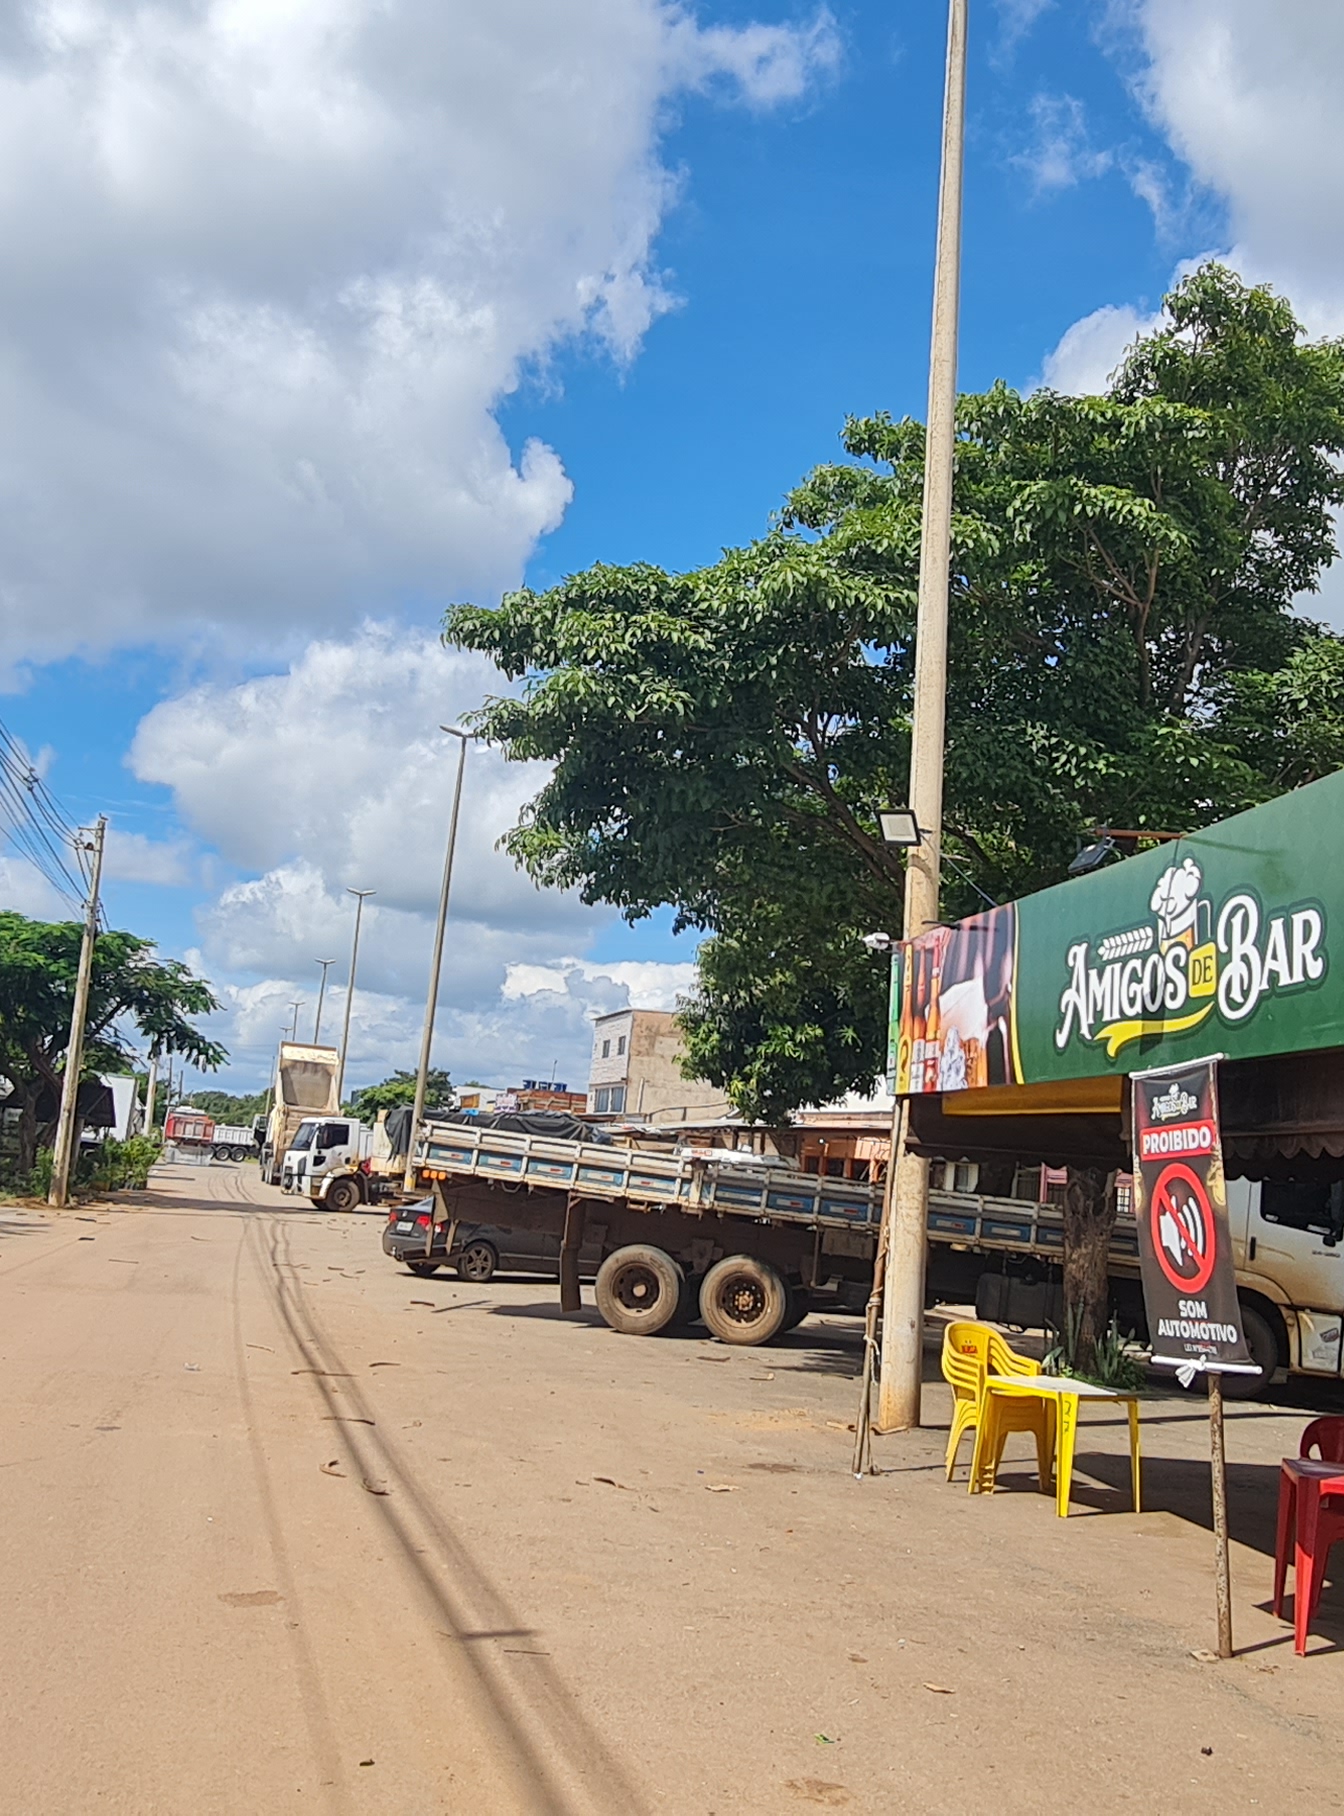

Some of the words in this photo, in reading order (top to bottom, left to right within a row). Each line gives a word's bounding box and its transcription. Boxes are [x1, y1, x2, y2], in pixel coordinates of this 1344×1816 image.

[1056, 942, 1188, 1048] AMIGOS
[1192, 955, 1214, 987] DE
[1217, 894, 1324, 1020] BAR
[1142, 1125, 1212, 1155] PROIBIDO
[1178, 1299, 1208, 1320] SOM
[1157, 1318, 1238, 1344] AUTOMOTIVO
